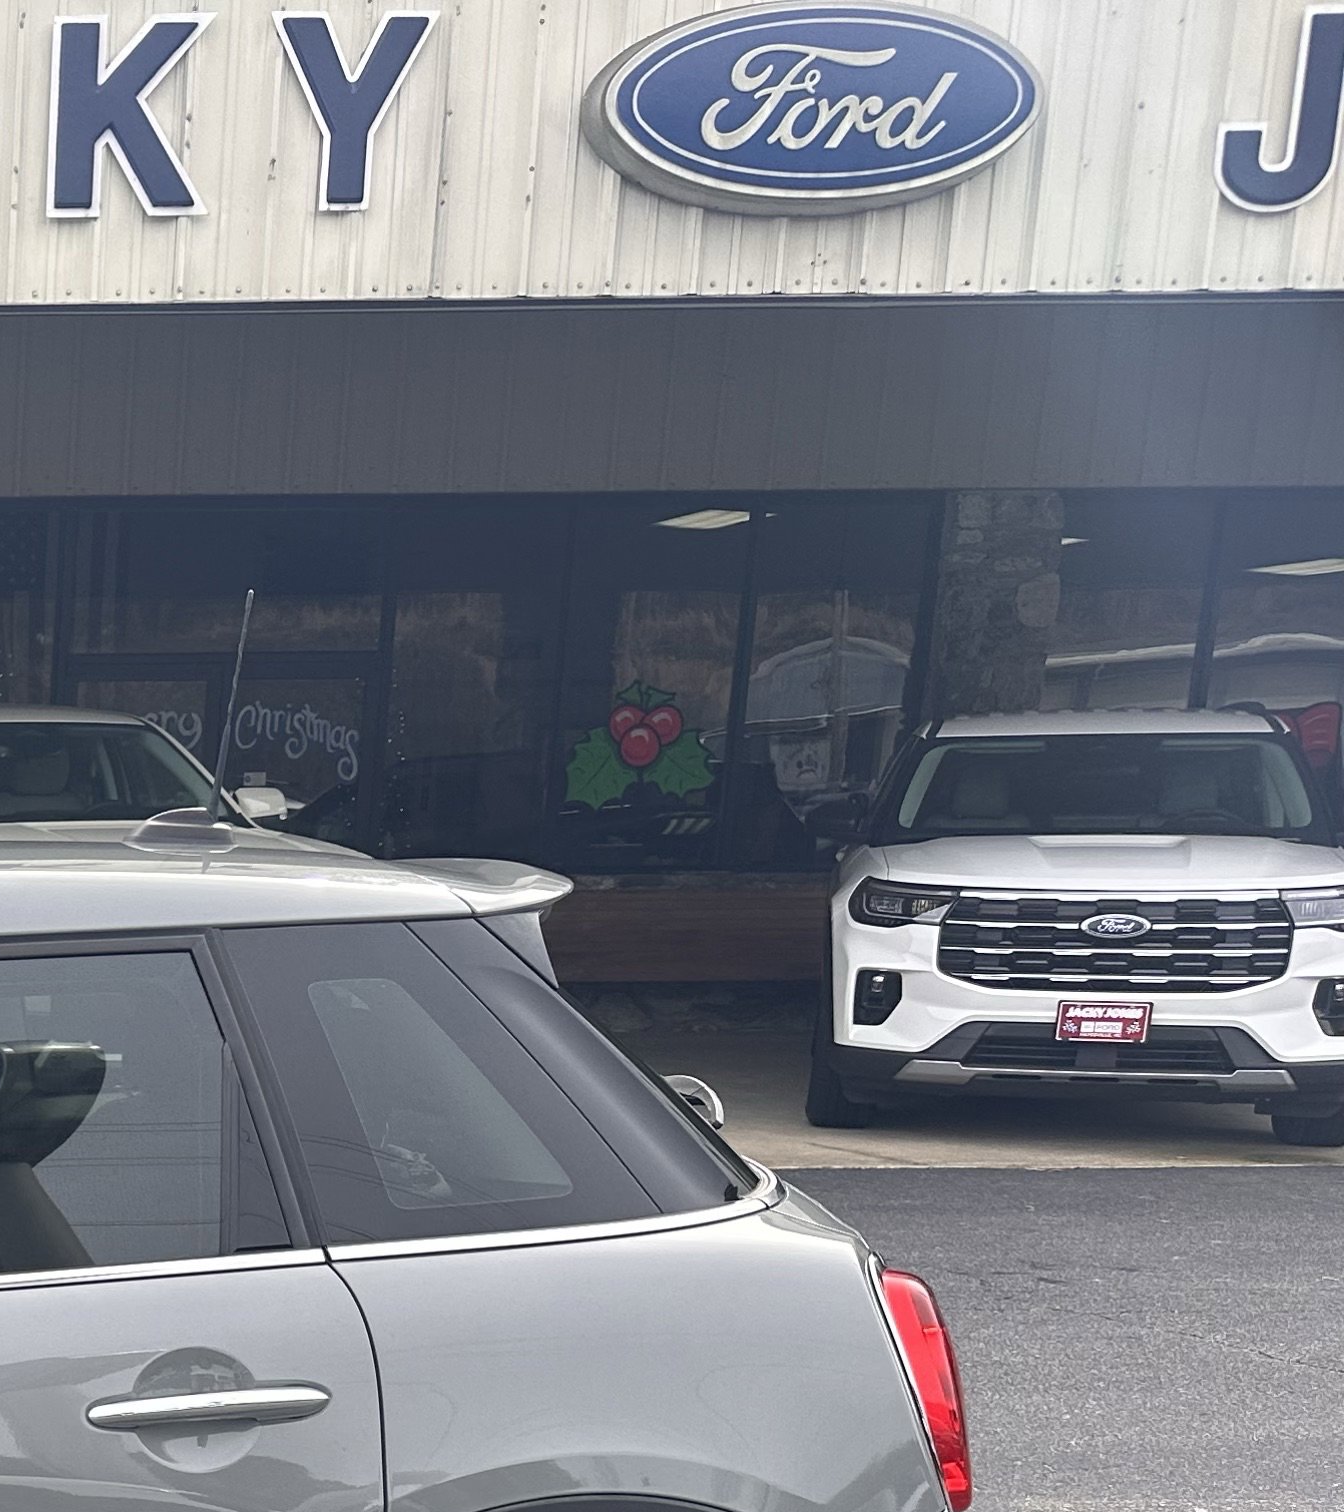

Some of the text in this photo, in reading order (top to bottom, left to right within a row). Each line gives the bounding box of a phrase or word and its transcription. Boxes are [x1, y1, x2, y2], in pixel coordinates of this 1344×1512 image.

[701, 43, 958, 150] Ford
[235, 701, 359, 781] Christmas
[1097, 918, 1135, 933] Ford
[1065, 1006, 1107, 1018] JACKY
